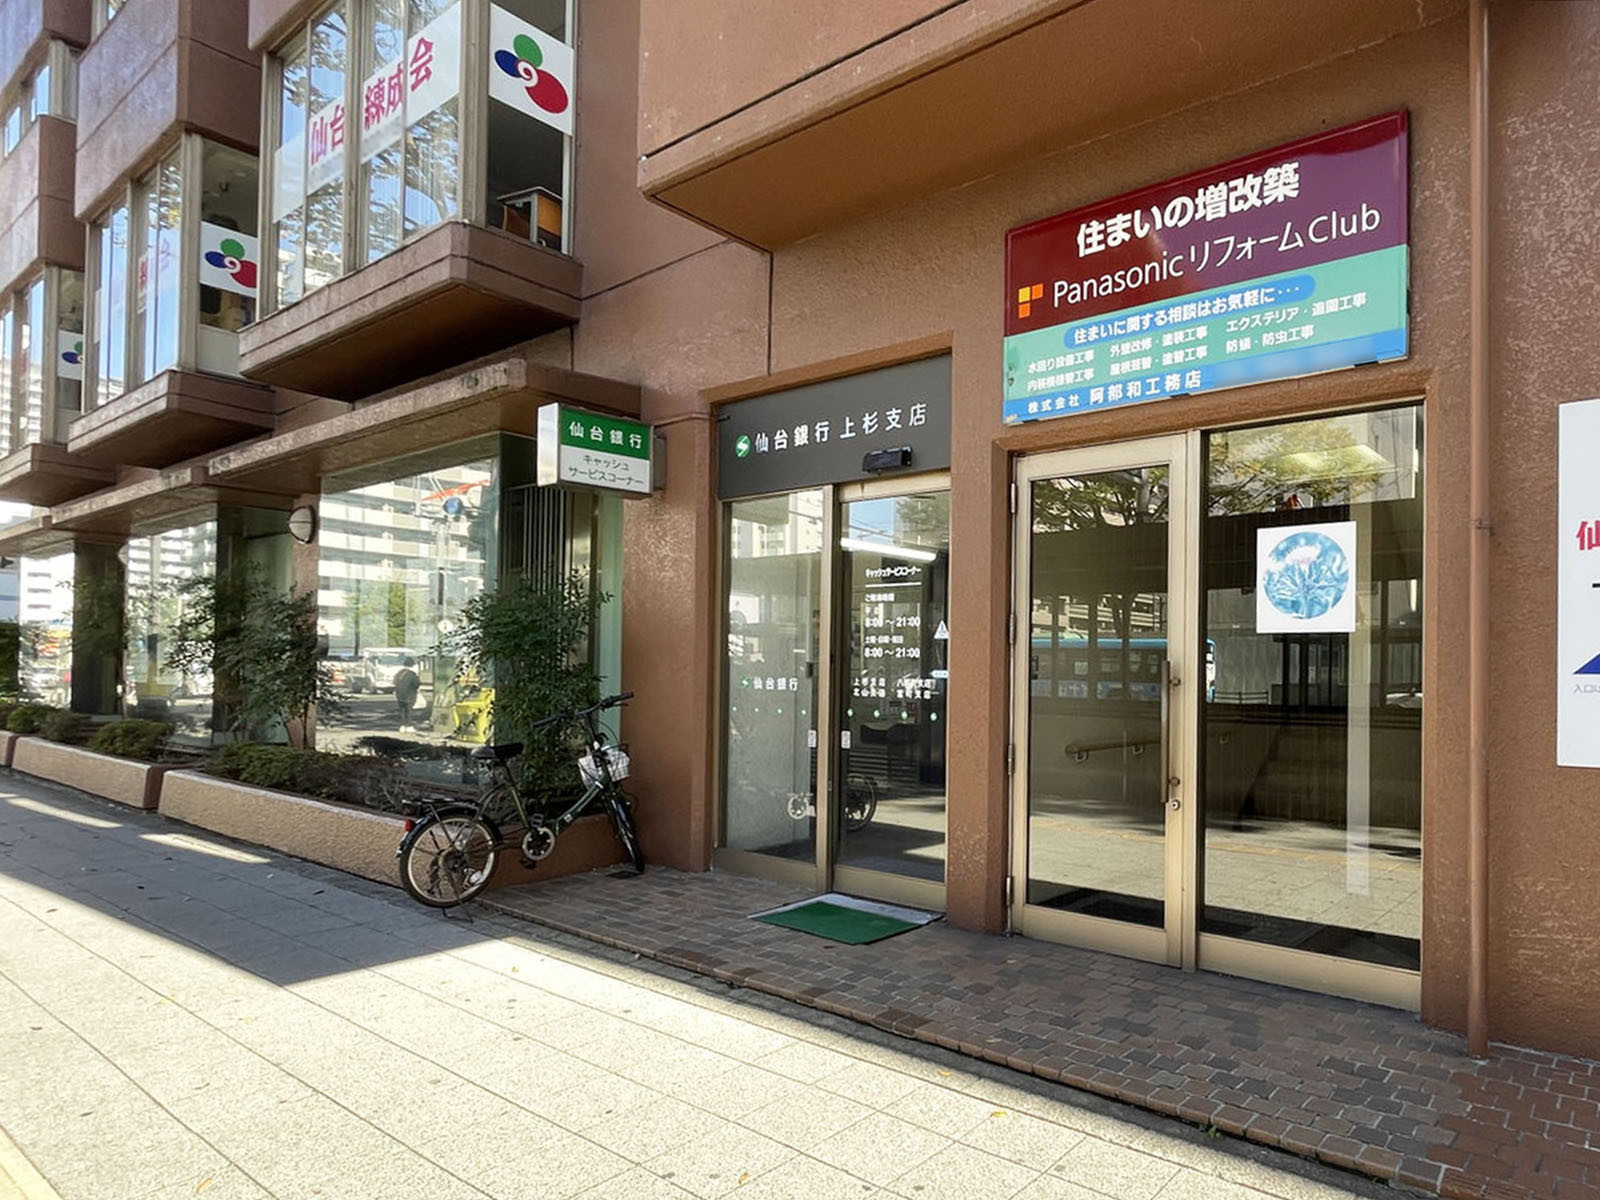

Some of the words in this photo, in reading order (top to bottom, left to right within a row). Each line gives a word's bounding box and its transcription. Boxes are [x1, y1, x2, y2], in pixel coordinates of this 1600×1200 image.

[1077, 161, 1300, 258] 住まいの増改築
[1053, 250, 1184, 309] Panasonic
[1190, 221, 1305, 272] リフォーム
[1308, 203, 1381, 243] Club
[1027, 394, 1080, 414] 株式会社
[1089, 369, 1202, 406] 阿部和工務店
[569, 421, 643, 449] 仙台銀行
[754, 420, 830, 454] 仙台銀行
[839, 402, 928, 440] 上杉支店
[568, 466, 645, 486] サービスコーナー
[583, 454, 630, 472] キャッシュ
